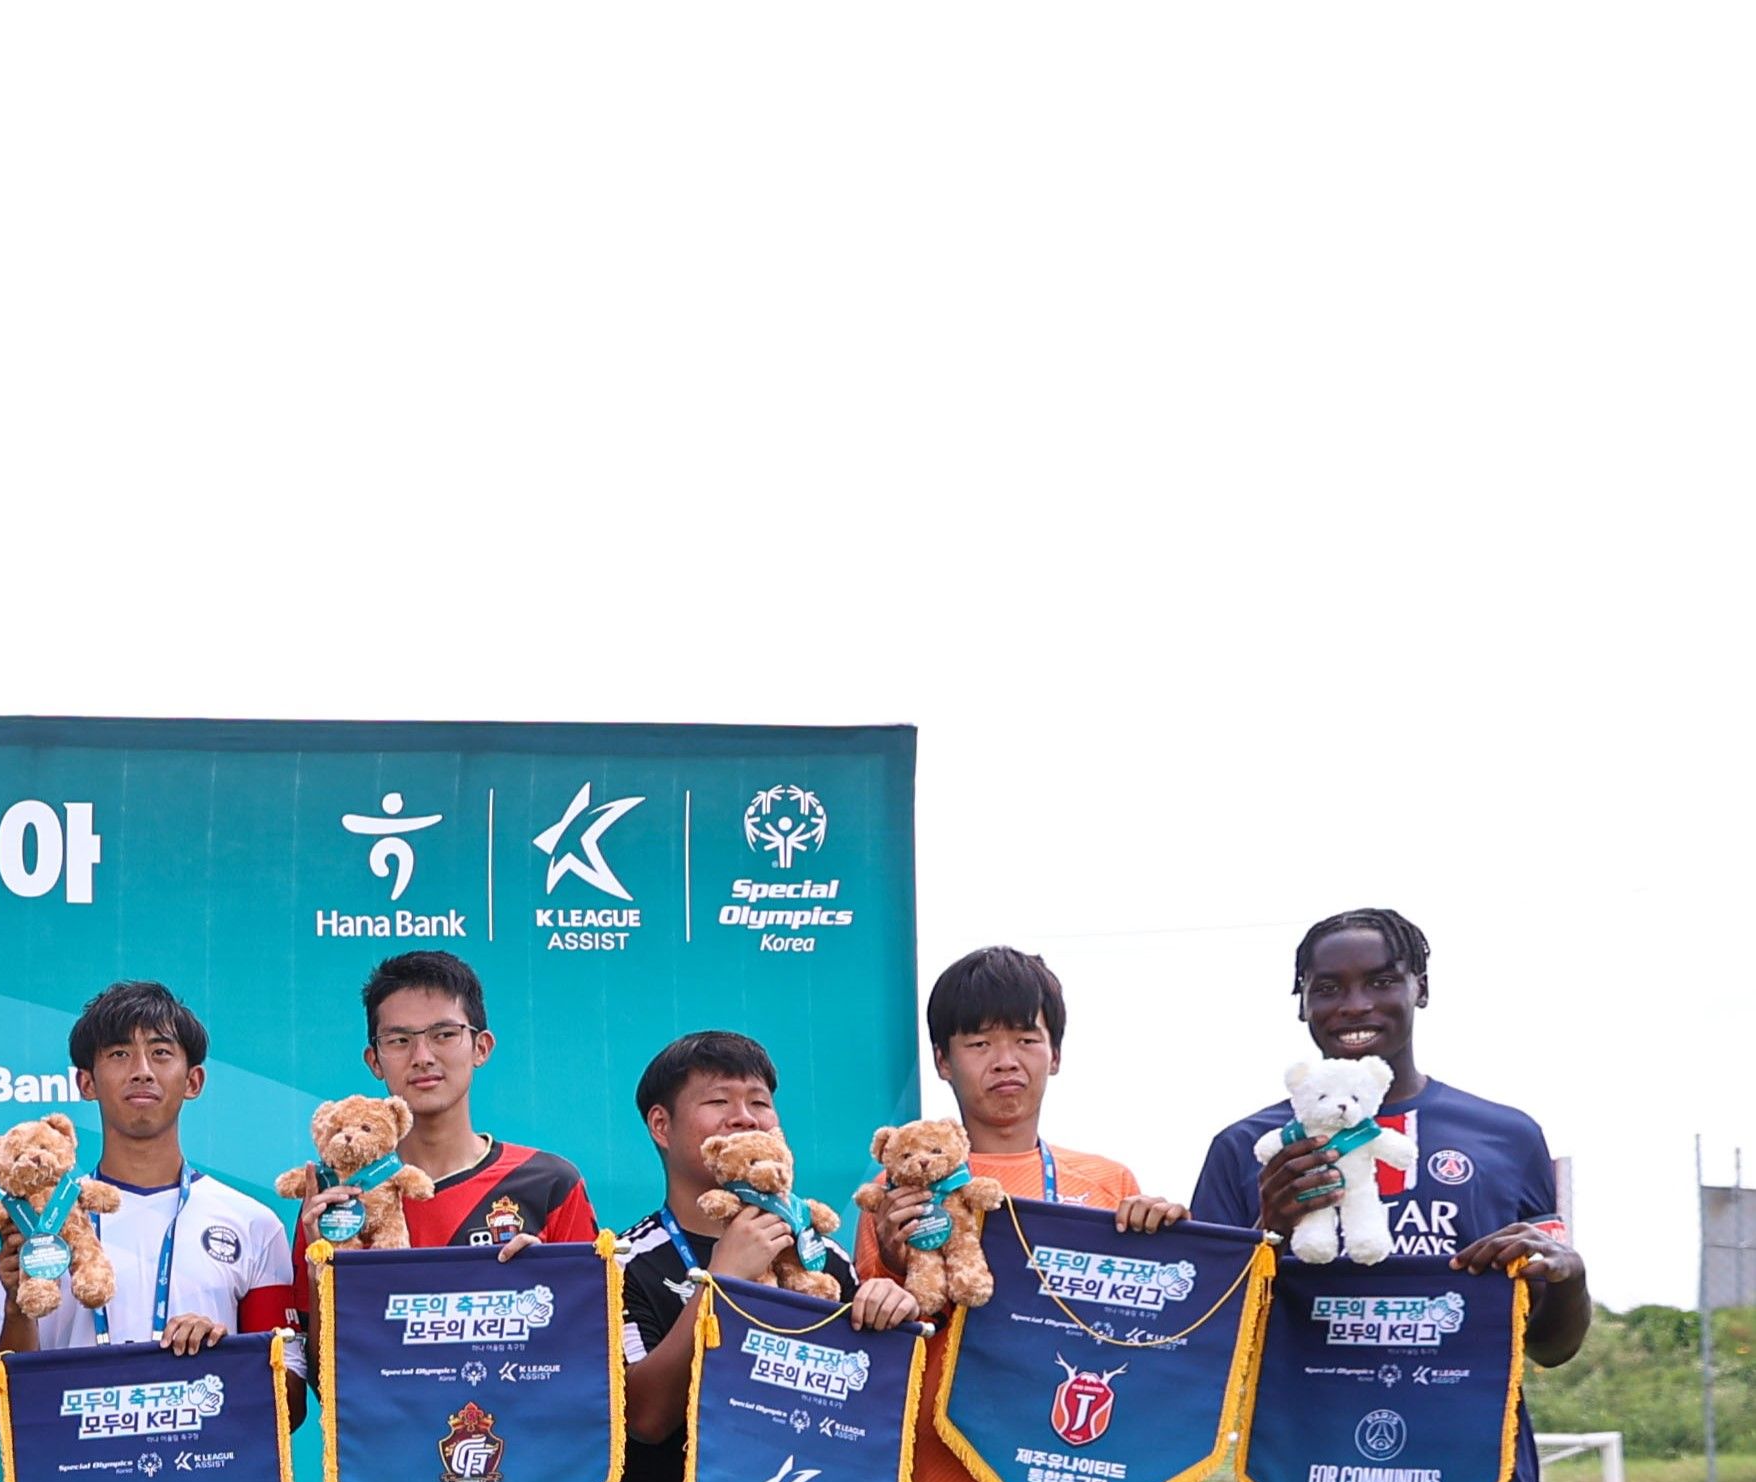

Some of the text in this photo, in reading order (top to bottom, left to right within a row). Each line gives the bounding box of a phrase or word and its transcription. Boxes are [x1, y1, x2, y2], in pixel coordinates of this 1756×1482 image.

[732, 879, 839, 901] Special
[317, 910, 466, 938] Hana Bank
[537, 909, 640, 928] K LEAGUE
[719, 905, 853, 930] Olympics
[548, 932, 629, 950] ASSIST
[760, 935, 816, 952] Korea
[1382, 1200, 1458, 1236] TAR
[1388, 1236, 1456, 1255] WAYS
[1035, 1249, 1157, 1283] 모두의 축구장
[1047, 1275, 1163, 1307] 모두의 K리그
[389, 1295, 515, 1318] 모두의 축구장
[1314, 1300, 1427, 1319] 모두의 축구장
[407, 1318, 528, 1340] 모두의 K리그
[1330, 1323, 1437, 1342] 모두의 K리그
[745, 1332, 841, 1371] 모두의 축구장
[755, 1359, 847, 1396] 모두의 K리그
[64, 1386, 186, 1413] 모두의 축구장
[83, 1410, 198, 1434] 모두의 K리그
[1366, 1410, 1398, 1424] PARIS
[195, 1460, 225, 1469] ASSIST
[204, 1452, 234, 1461] LEAGUE
[1015, 1448, 1127, 1479] 제주유나이티드
